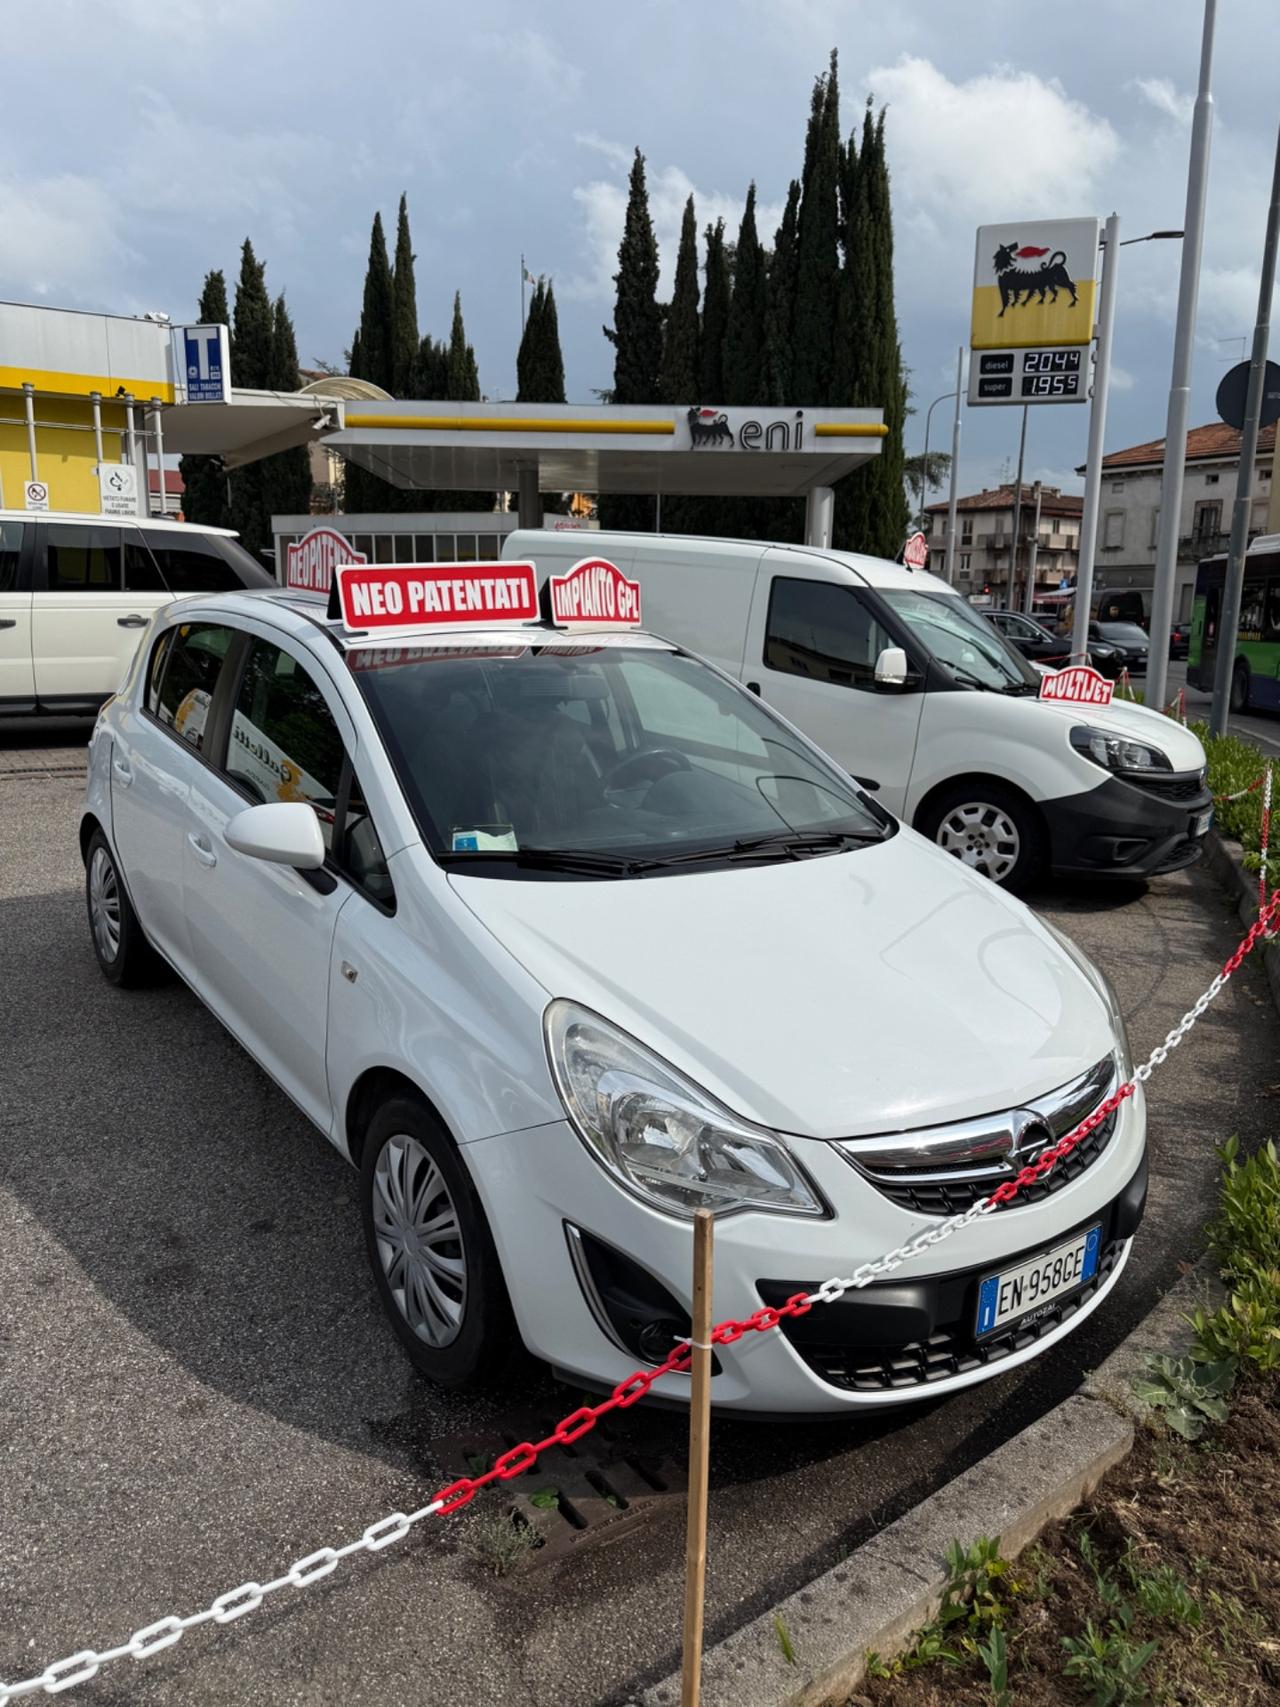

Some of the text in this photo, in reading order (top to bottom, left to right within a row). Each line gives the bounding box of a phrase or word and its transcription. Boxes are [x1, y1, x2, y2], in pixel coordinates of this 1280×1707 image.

[187, 328, 218, 380] T
[985, 359, 1009, 370] diesel
[984, 383, 1006, 393] super
[740, 410, 803, 450] eni
[290, 534, 364, 591] NEOPATE
[351, 577, 530, 616] NEO PATENTATI
[555, 566, 639, 619] IMPIANTO GPL
[1043, 670, 1111, 703] MULTIJET
